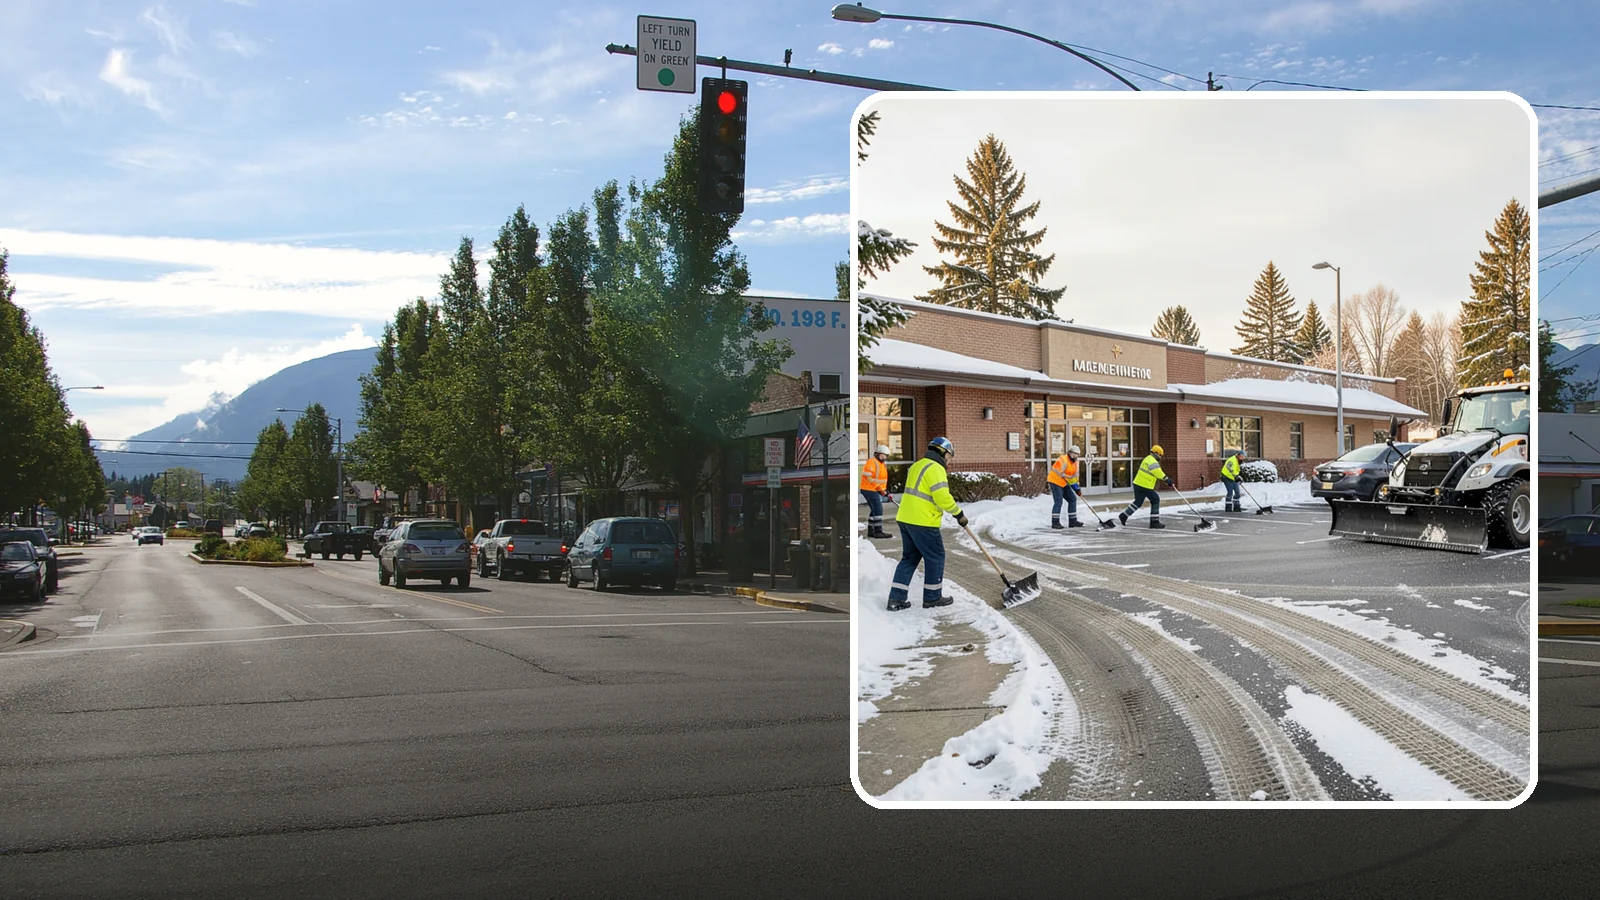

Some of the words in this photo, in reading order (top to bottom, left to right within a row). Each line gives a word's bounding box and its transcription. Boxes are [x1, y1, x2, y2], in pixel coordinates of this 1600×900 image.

[643, 24, 663, 34] LEFT
[668, 26, 690, 36] TURN
[652, 38, 682, 51] YIELD
[644, 54, 656, 63] ON
[661, 55, 688, 66] GREEN
[762, 307, 786, 327] O.
[791, 309, 826, 328] 198
[831, 311, 847, 329] F.
